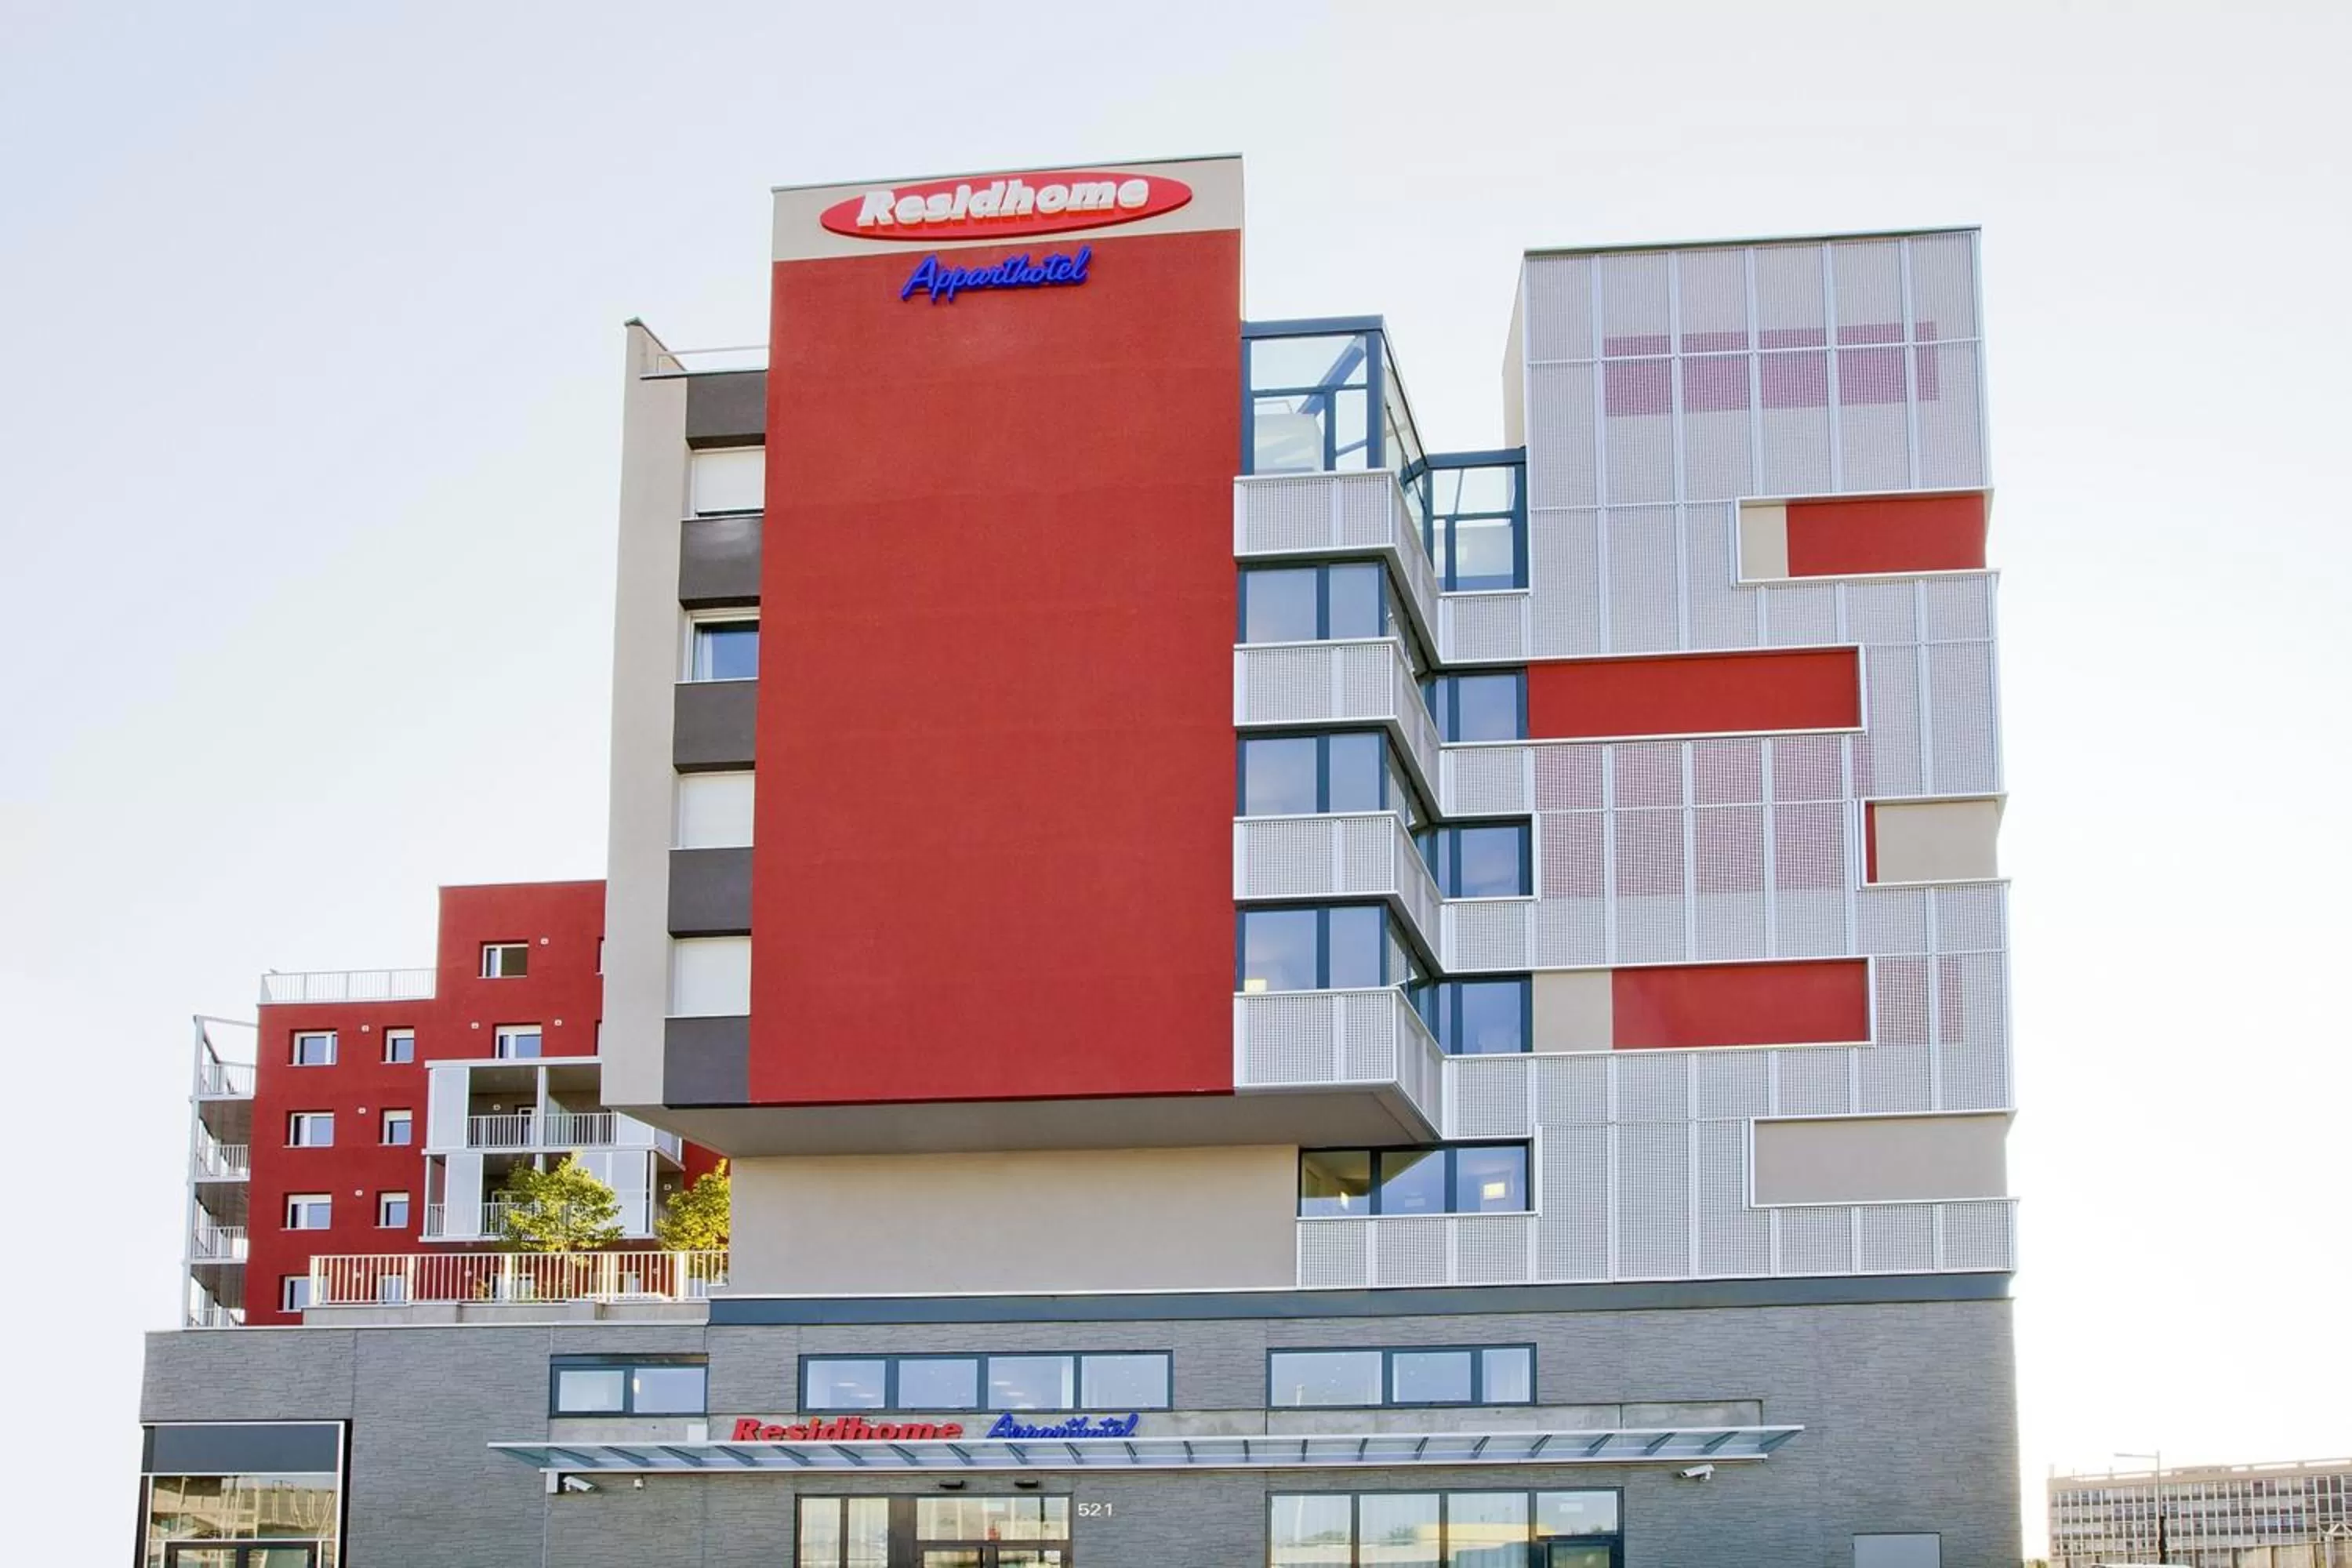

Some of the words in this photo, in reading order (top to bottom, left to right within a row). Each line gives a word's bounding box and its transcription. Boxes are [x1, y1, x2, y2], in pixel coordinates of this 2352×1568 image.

[857, 179, 1149, 227] Residhome
[901, 245, 1092, 303] Apparthotel
[731, 1416, 964, 1441] Residhome
[1078, 1502, 1112, 1518] 521
